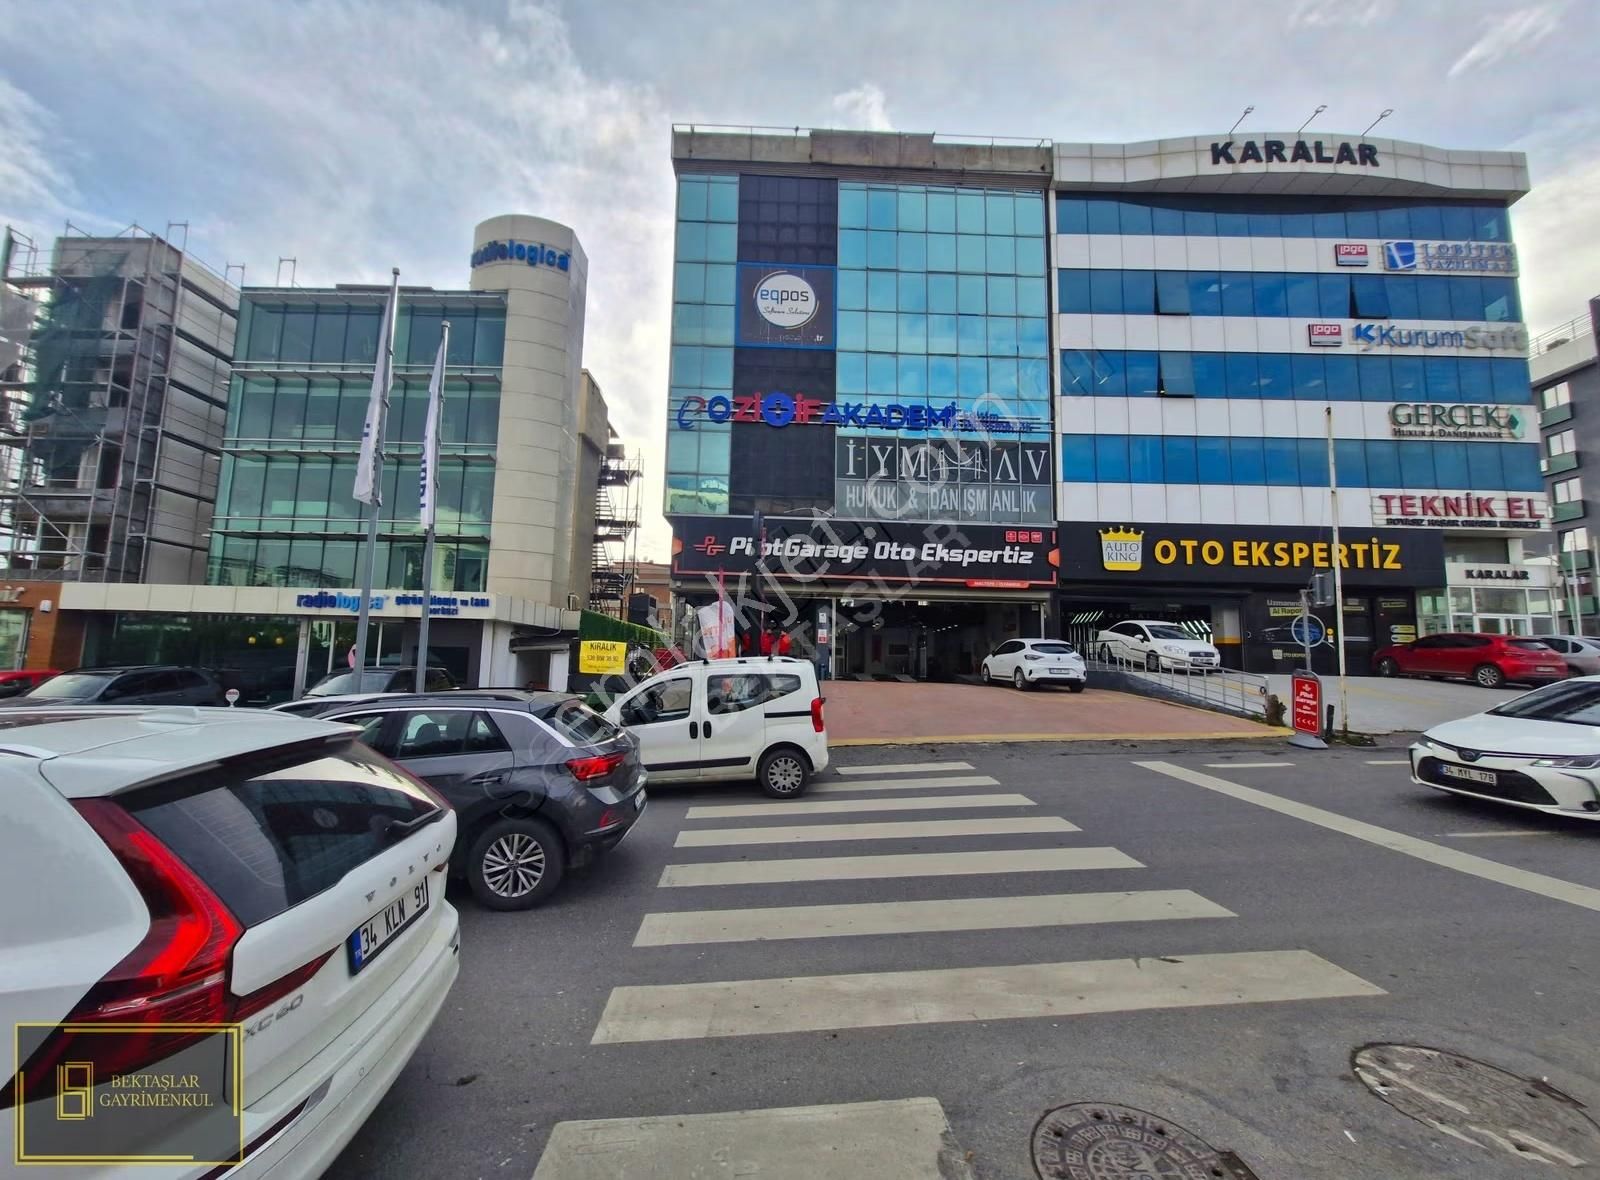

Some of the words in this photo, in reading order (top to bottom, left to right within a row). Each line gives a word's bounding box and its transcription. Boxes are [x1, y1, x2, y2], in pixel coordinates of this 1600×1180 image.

[1210, 140, 1380, 167] KARALAR
[760, 289, 809, 305] eqpos
[821, 400, 957, 431] AKADEMİ
[1391, 403, 1505, 430] GERÇEK
[846, 486, 897, 509] HUKUK
[909, 487, 919, 509] &
[1379, 492, 1496, 517] TEKNİK
[1507, 497, 1545, 518] EL
[729, 536, 869, 564] PiotGarage
[874, 537, 915, 561] Oto
[921, 543, 1034, 567] Ekspertiz
[1104, 542, 1139, 552] AUTO
[1107, 551, 1137, 562] KING
[1154, 539, 1224, 566] OTO
[1232, 537, 1403, 569] EKSPERTİZ
[1465, 569, 1530, 580] KARALAR
[361, 922, 378, 955] 34
[384, 897, 406, 936] KLN
[414, 882, 426, 909] 91
